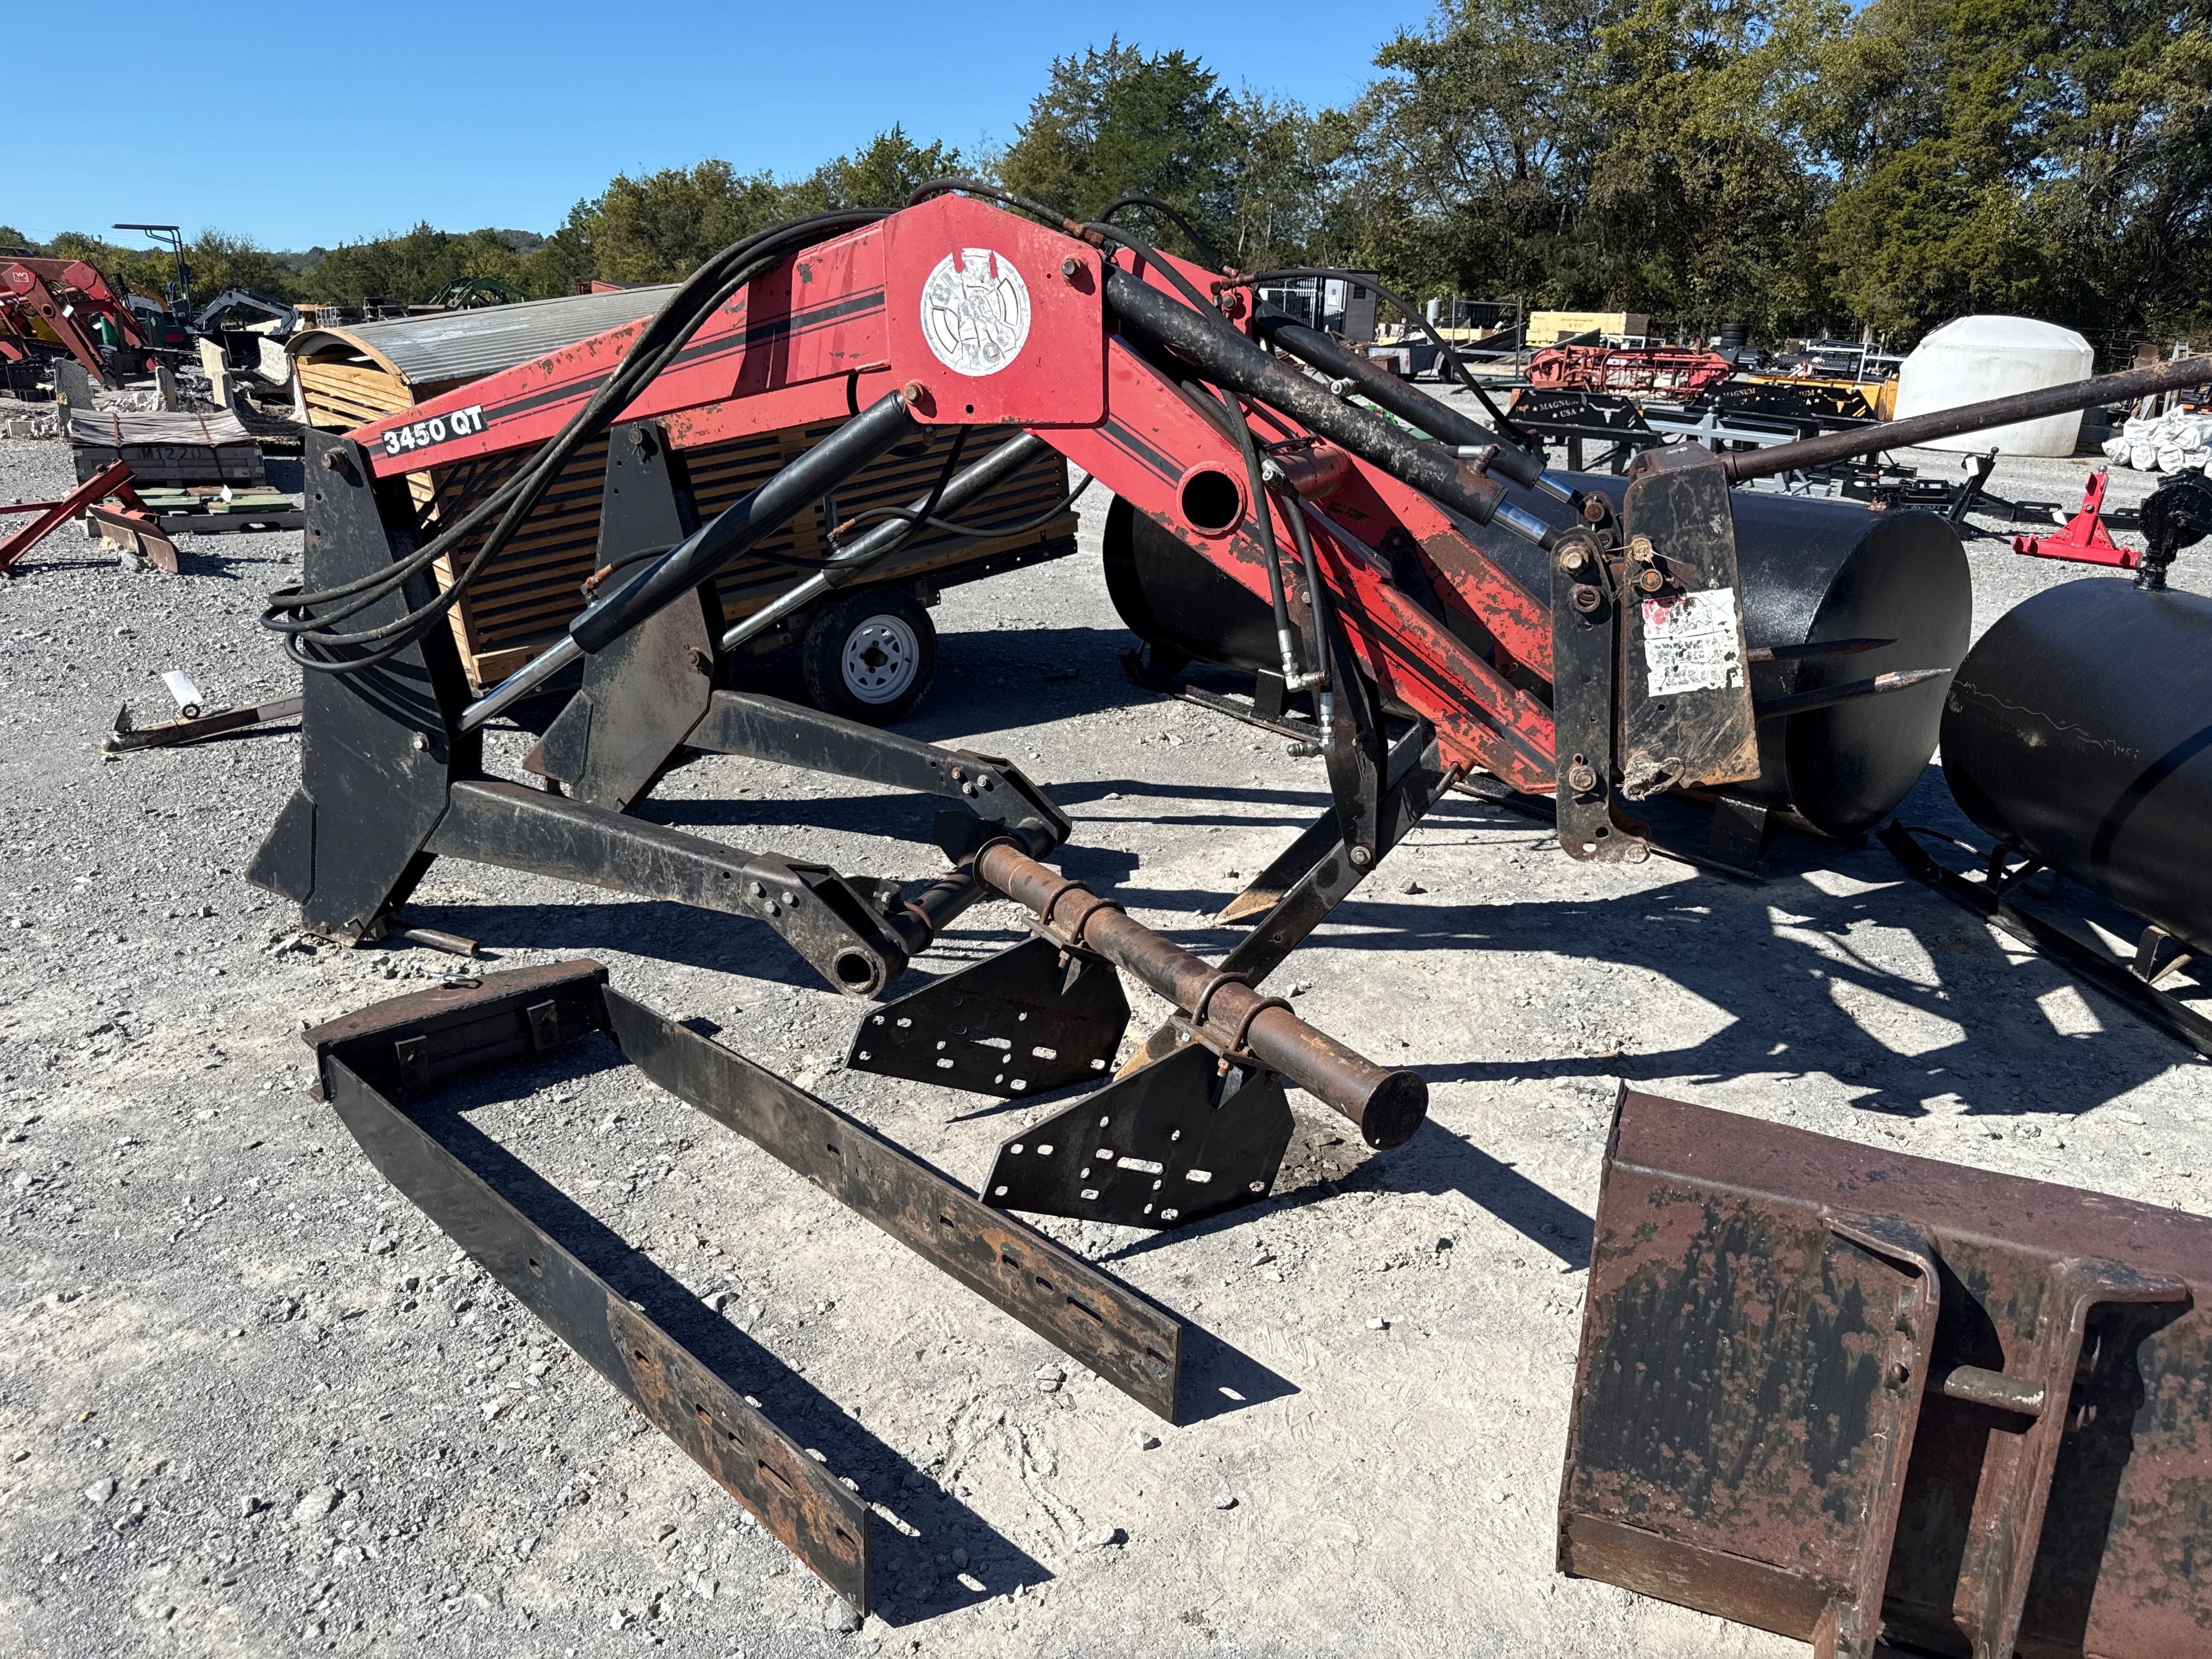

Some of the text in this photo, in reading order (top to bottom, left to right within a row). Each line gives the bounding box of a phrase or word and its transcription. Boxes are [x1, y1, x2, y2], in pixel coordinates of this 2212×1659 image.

[1540, 399, 1579, 411] MAGNU
[1559, 408, 1577, 418] USA
[384, 405, 482, 454] 3450 QT
